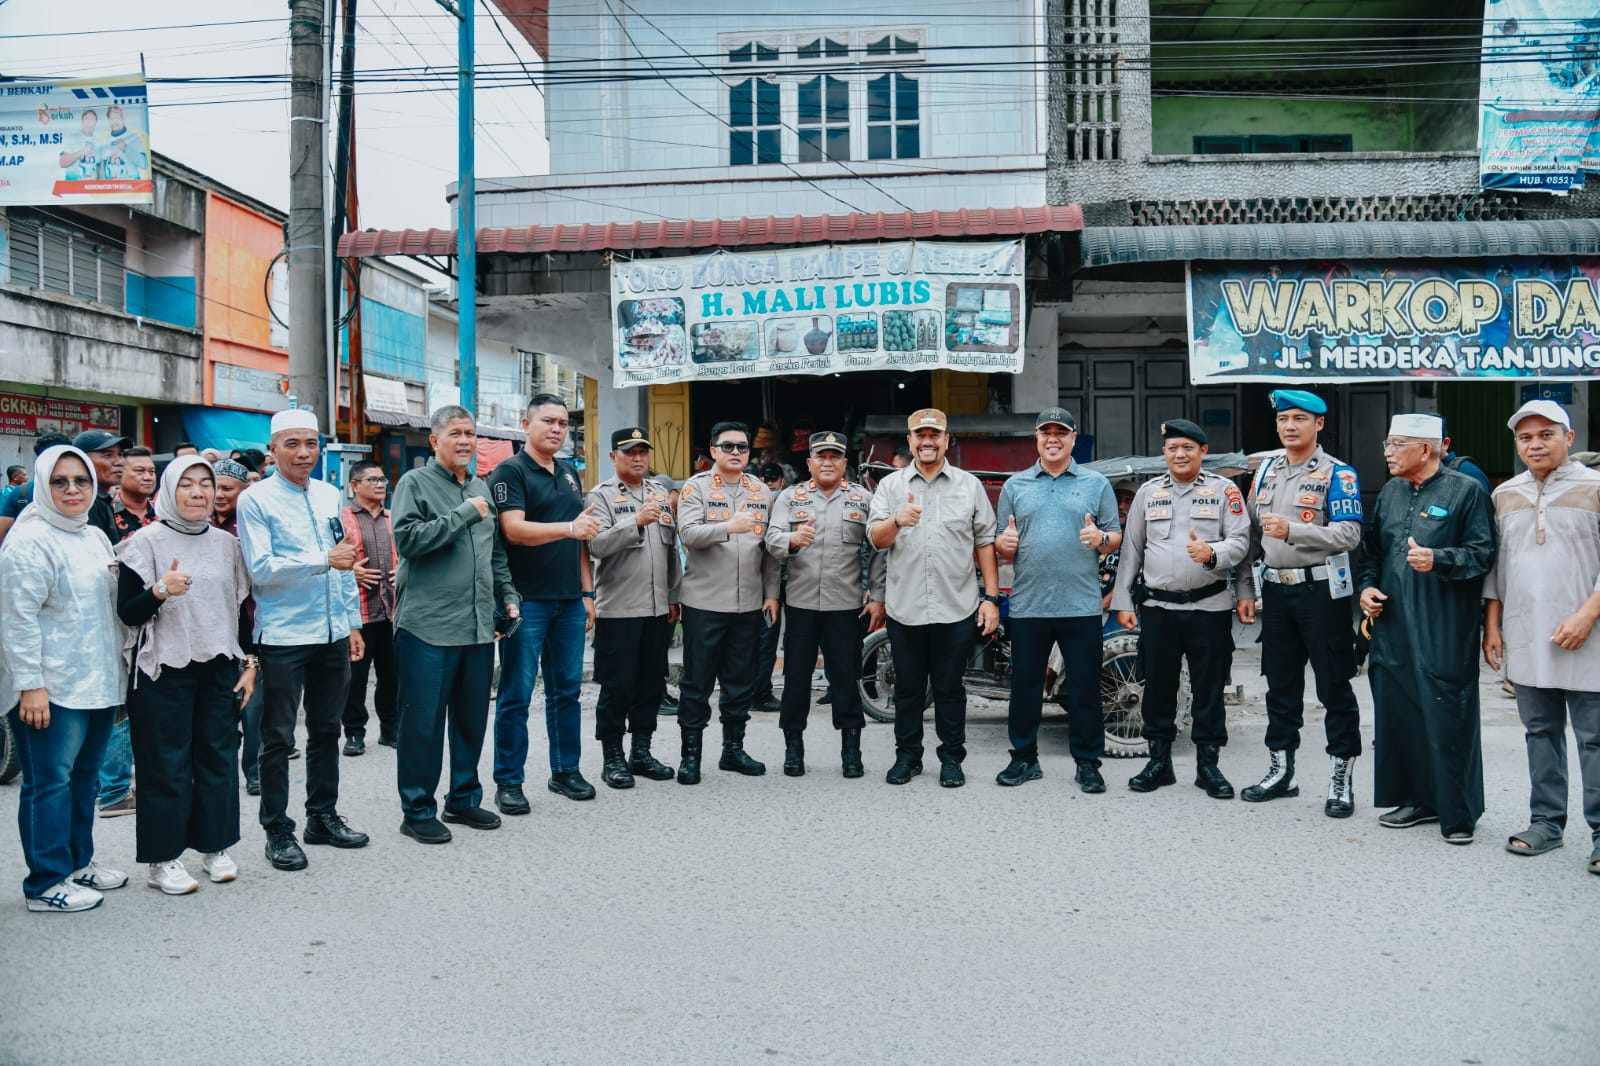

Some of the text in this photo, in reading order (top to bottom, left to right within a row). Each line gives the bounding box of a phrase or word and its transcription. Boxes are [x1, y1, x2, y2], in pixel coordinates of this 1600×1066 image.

[11, 134, 36, 146] S.H.,
[39, 132, 63, 144] M.Si
[1520, 176, 1543, 185] HUB.
[614, 262, 684, 293] TOKO
[691, 256, 784, 289] BUNGA
[701, 280, 931, 317] H. MALI LUBIS
[1220, 278, 1502, 338] WARKOP
[1275, 346, 1311, 369] JL.
[1319, 345, 1455, 369] MERDEKA
[769, 358, 799, 371] Aneka
[5, 417, 26, 425] UDUK
[1299, 484, 1326, 492] POLRI
